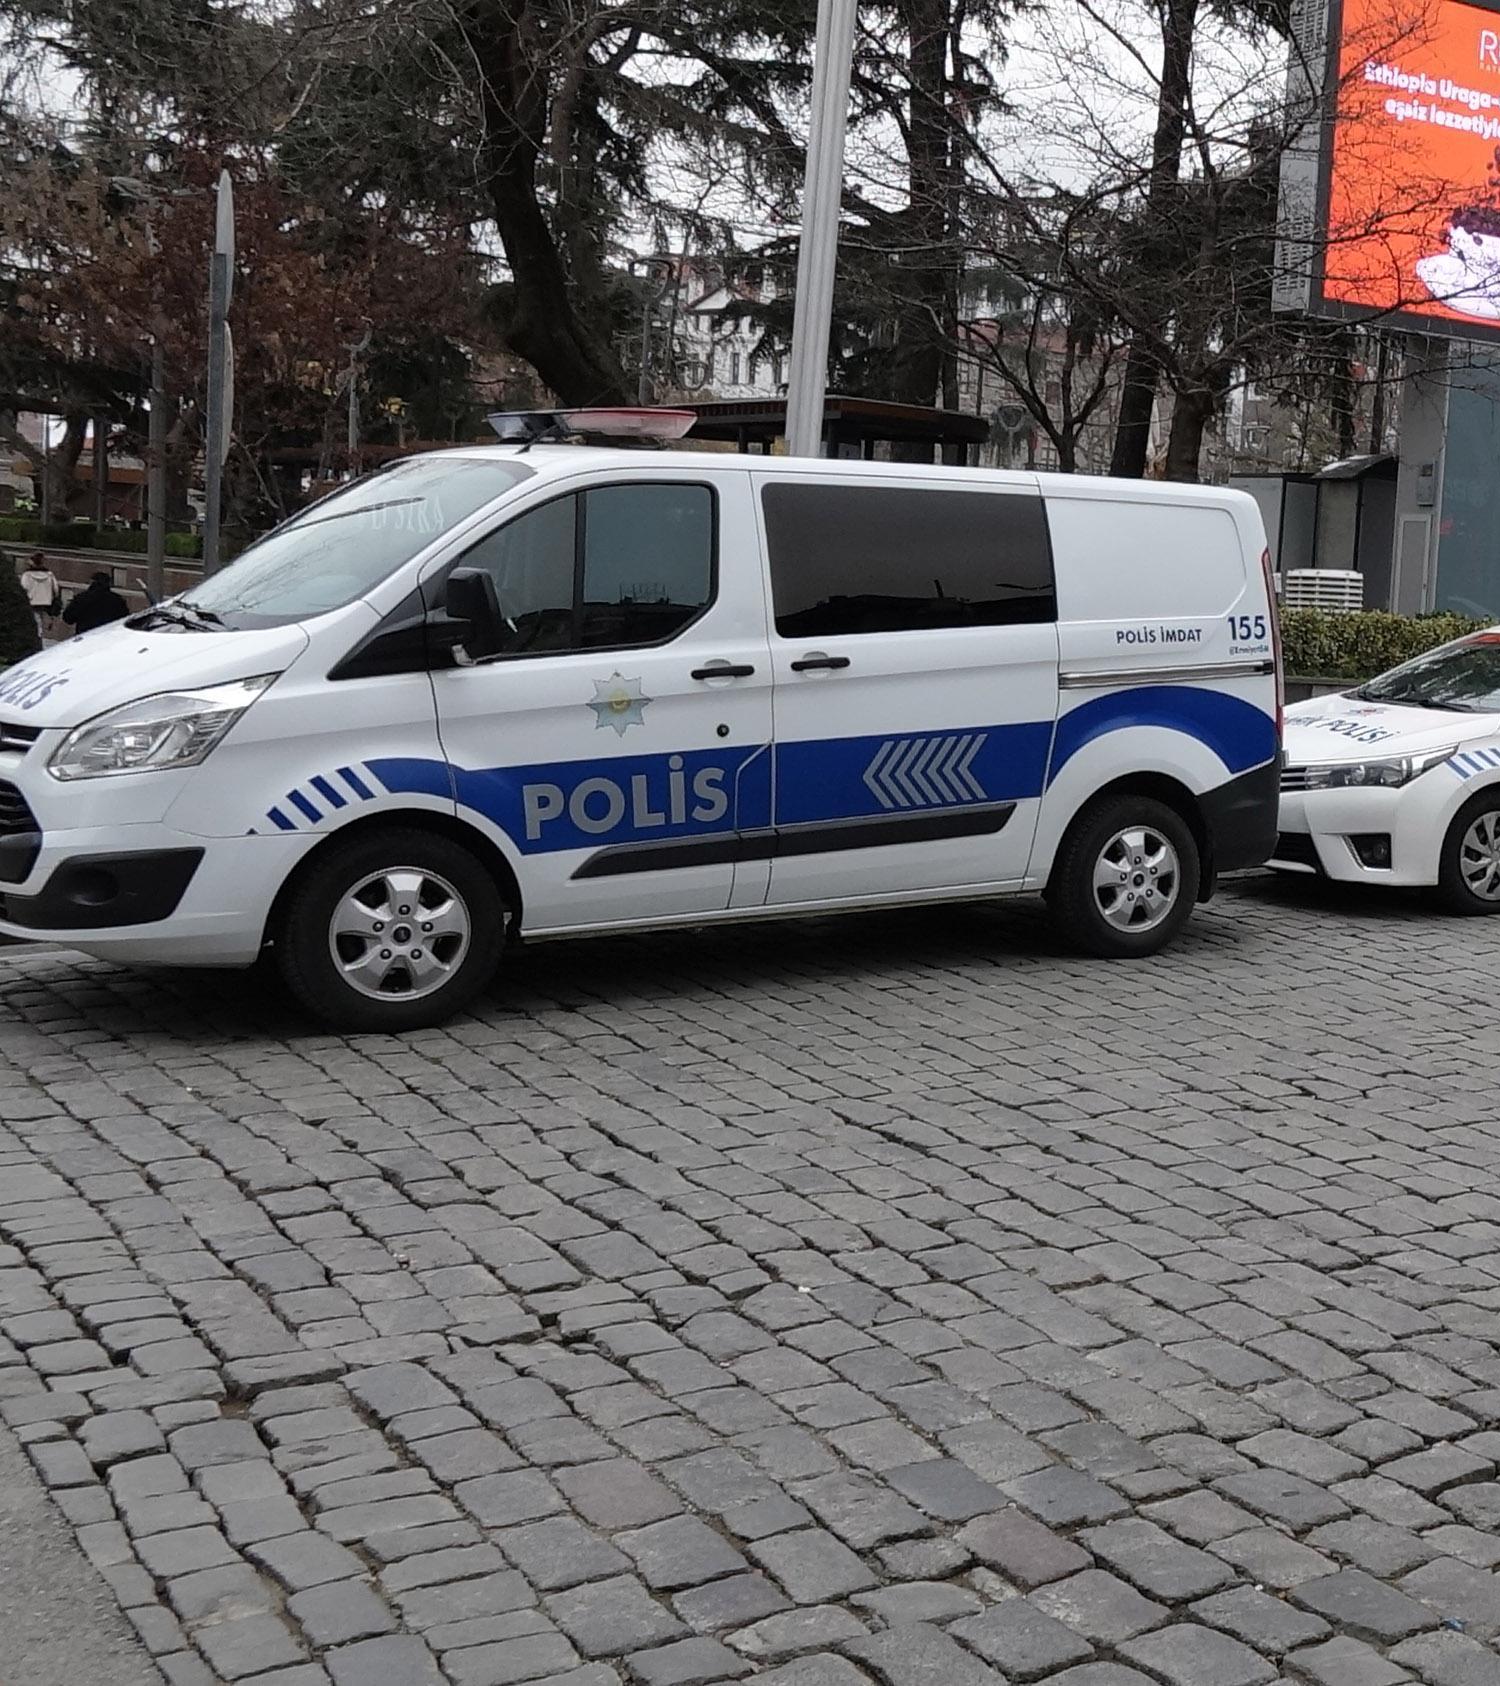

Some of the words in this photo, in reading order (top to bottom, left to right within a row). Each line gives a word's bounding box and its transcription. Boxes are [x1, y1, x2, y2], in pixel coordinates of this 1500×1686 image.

[1116, 626, 1157, 644] POLİS
[1160, 626, 1202, 643] İMDAT
[1228, 615, 1266, 640] 155
[522, 754, 728, 840] POLİS
